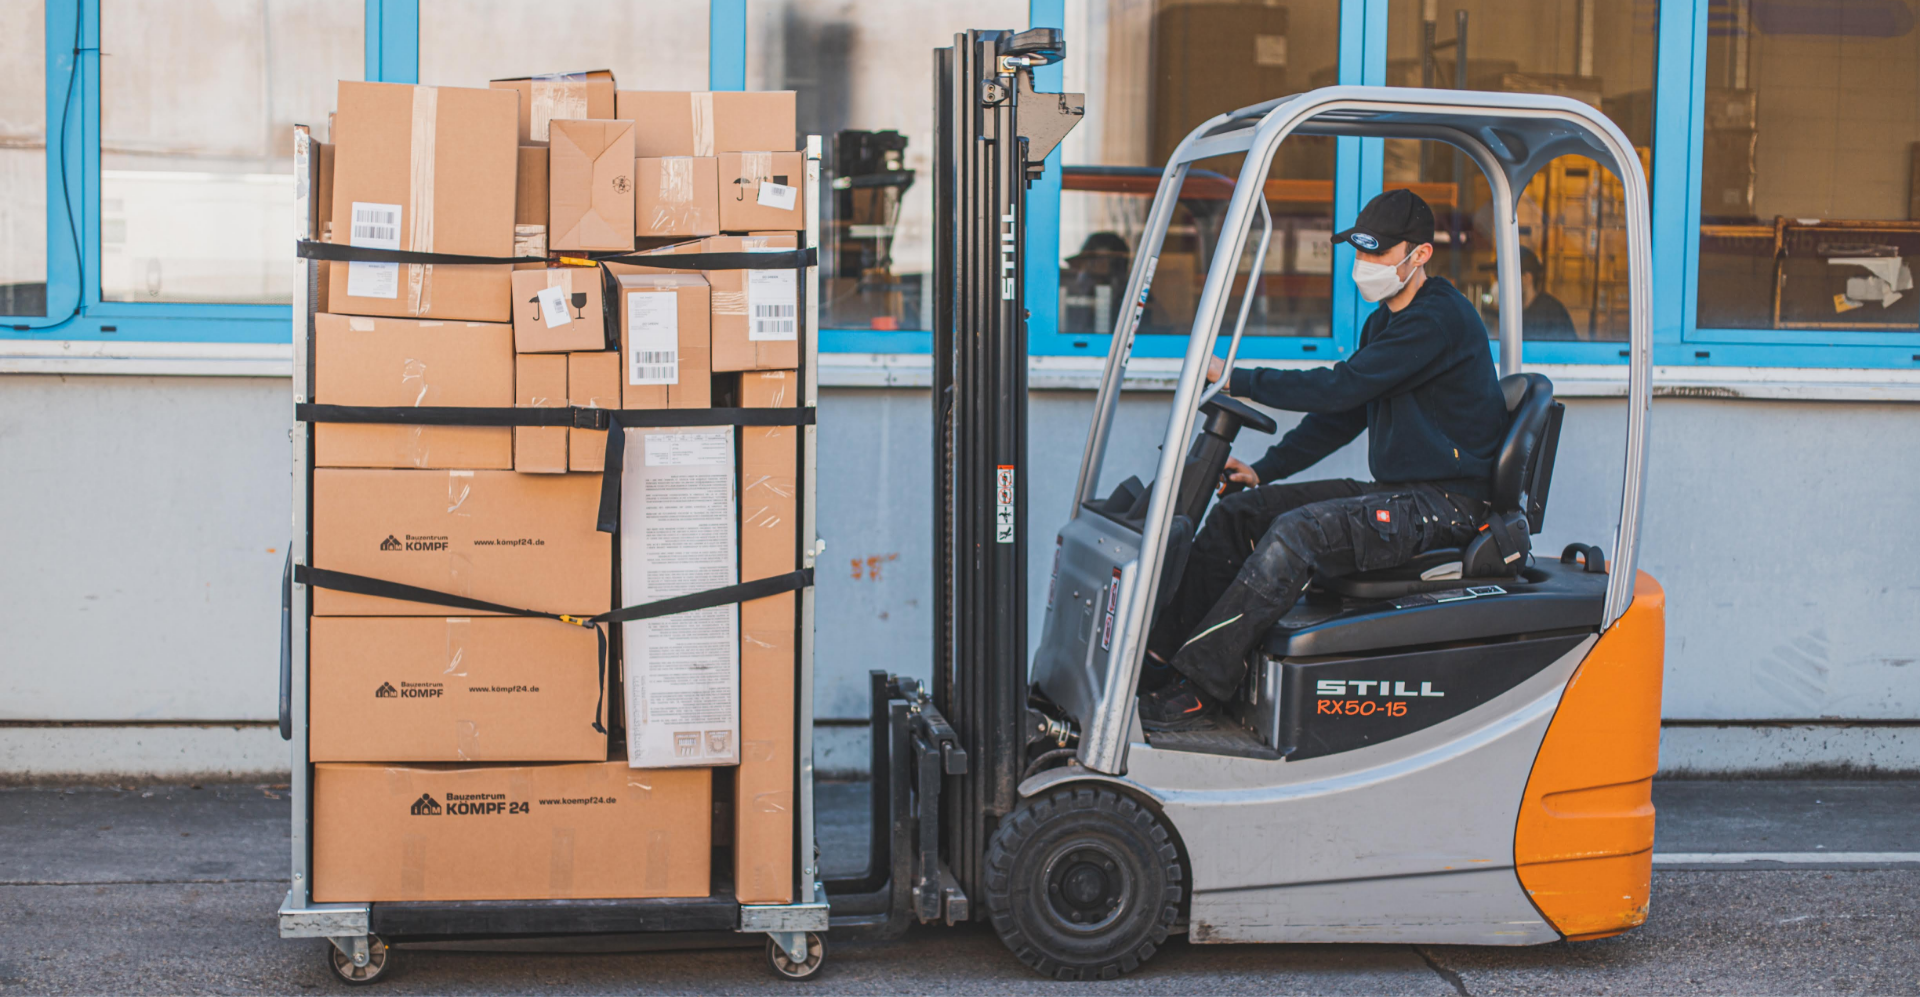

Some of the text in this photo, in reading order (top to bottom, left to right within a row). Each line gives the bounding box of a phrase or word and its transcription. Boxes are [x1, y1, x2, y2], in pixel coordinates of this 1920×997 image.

[1001, 203, 1015, 300] STILL
[406, 540, 448, 551] KÖMPF
[474, 538, 545, 547] www.kömpf24.de
[401, 688, 443, 698] KÖMPF
[469, 685, 540, 694] www.kömpf24.de
[1316, 679, 1445, 697] STILL
[1317, 699, 1408, 717] RX50-15
[446, 793, 506, 802] Bauzentrum
[539, 797, 617, 806] www.koempf24.de
[446, 801, 530, 815] KÖMPF 24
